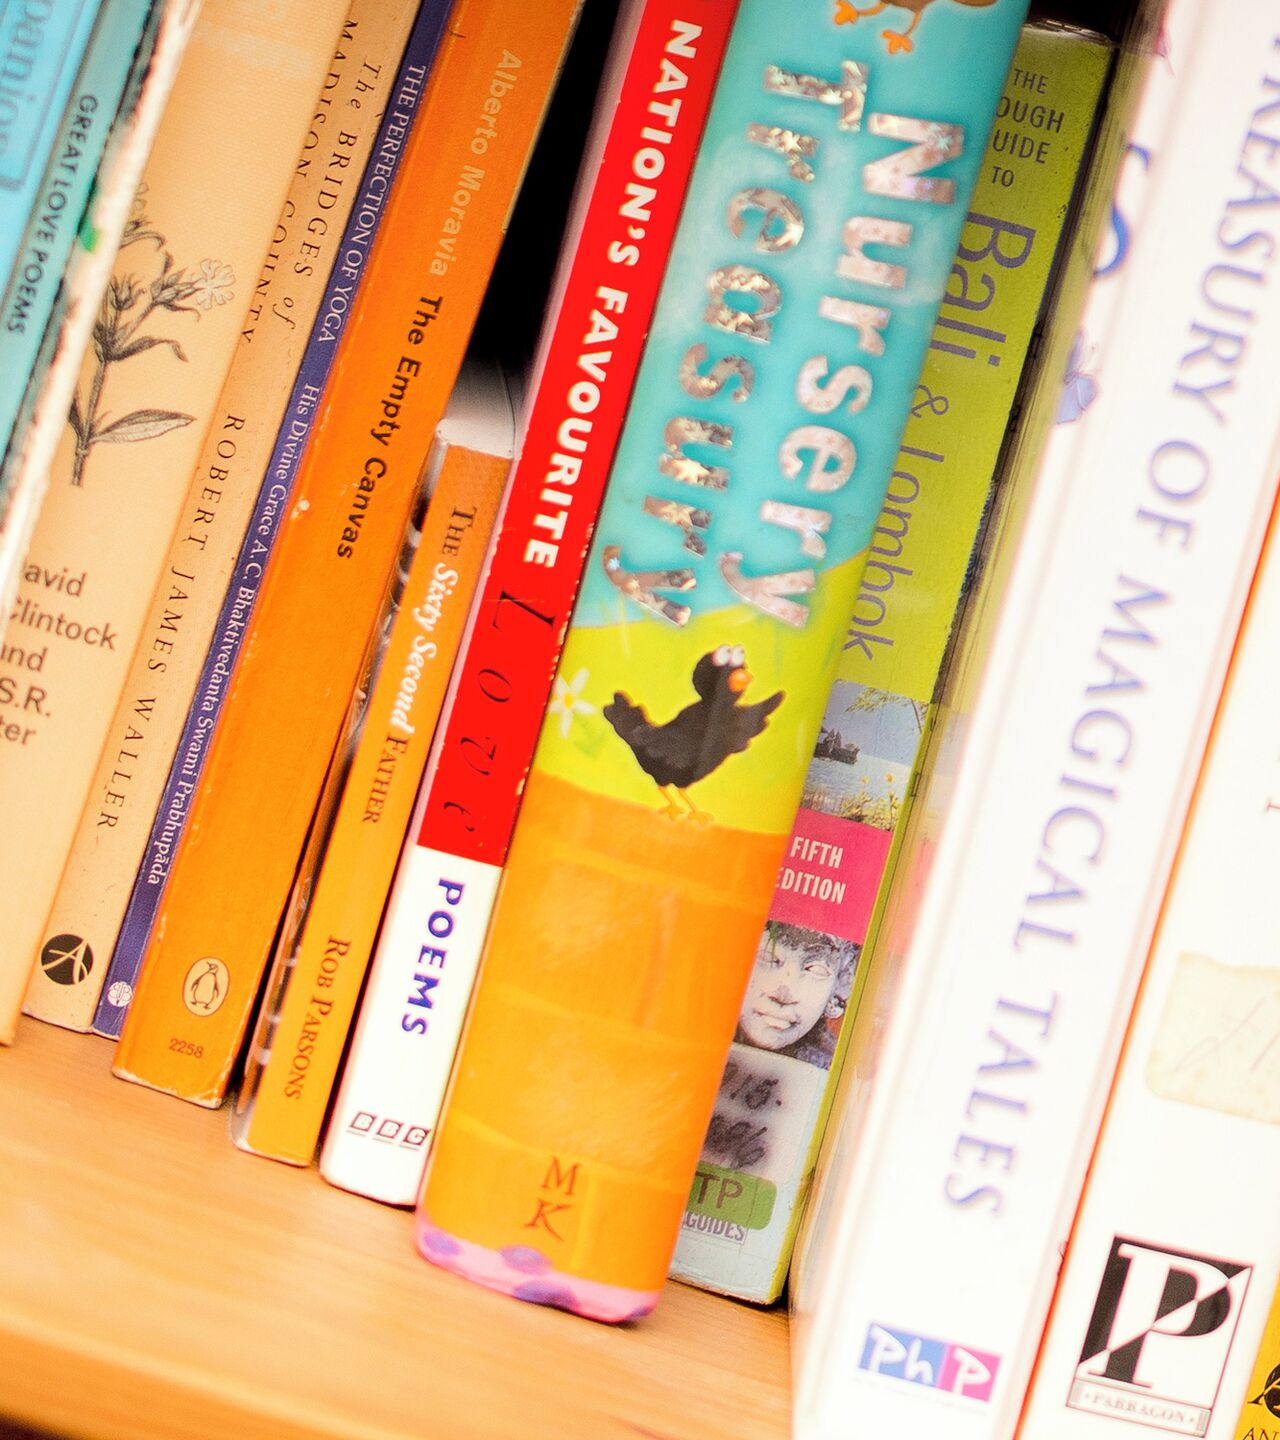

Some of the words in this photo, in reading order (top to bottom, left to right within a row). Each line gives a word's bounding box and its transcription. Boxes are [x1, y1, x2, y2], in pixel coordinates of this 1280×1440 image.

[349, 61, 382, 110] The
[402, 62, 426, 100] THE
[469, 48, 525, 155] Alberto
[996, 94, 1065, 136] OUGH
[1012, 67, 1049, 95] THE
[68, 94, 98, 165] GREAT
[607, 20, 704, 269] NATION'S
[992, 128, 1052, 166] UIDE
[41, 169, 76, 247] LOVE
[294, 129, 359, 278] BRIDGES
[350, 100, 408, 244] PERFECTION
[990, 164, 1016, 190] TO
[346, 246, 366, 272] OF
[428, 165, 486, 278] Moravia
[7, 248, 44, 335] POEMS
[275, 294, 296, 329] of
[317, 273, 356, 343] YOGA
[408, 295, 444, 346] The
[602, 59, 871, 629] Treasury
[719, 111, 966, 629] Nursery
[282, 410, 313, 472] Divine
[369, 355, 422, 447] Empty
[522, 284, 630, 570] FAVOURITE
[188, 413, 246, 552] ROBERT
[256, 477, 287, 537] Grace
[335, 457, 389, 560] Canvas
[1136, 439, 1213, 553] OF
[440, 505, 479, 558] THE
[147, 567, 195, 676] JAMES
[197, 587, 253, 714] Bhaktivedanta
[388, 635, 438, 733] Second
[97, 695, 158, 829] WALLER
[179, 715, 213, 779] Swami
[361, 733, 411, 824] FATHER
[1011, 571, 1171, 952] MAGICAL
[789, 836, 844, 869] FIFTH
[319, 934, 353, 988] ROB
[400, 876, 467, 1036] POEMS
[167, 1037, 205, 1060] 2258
[283, 993, 335, 1100] PARSONS
[346, 1112, 430, 1147] BBC
[944, 989, 1060, 1216] TALES
[539, 1155, 581, 1197] M
[523, 1196, 574, 1241] K
